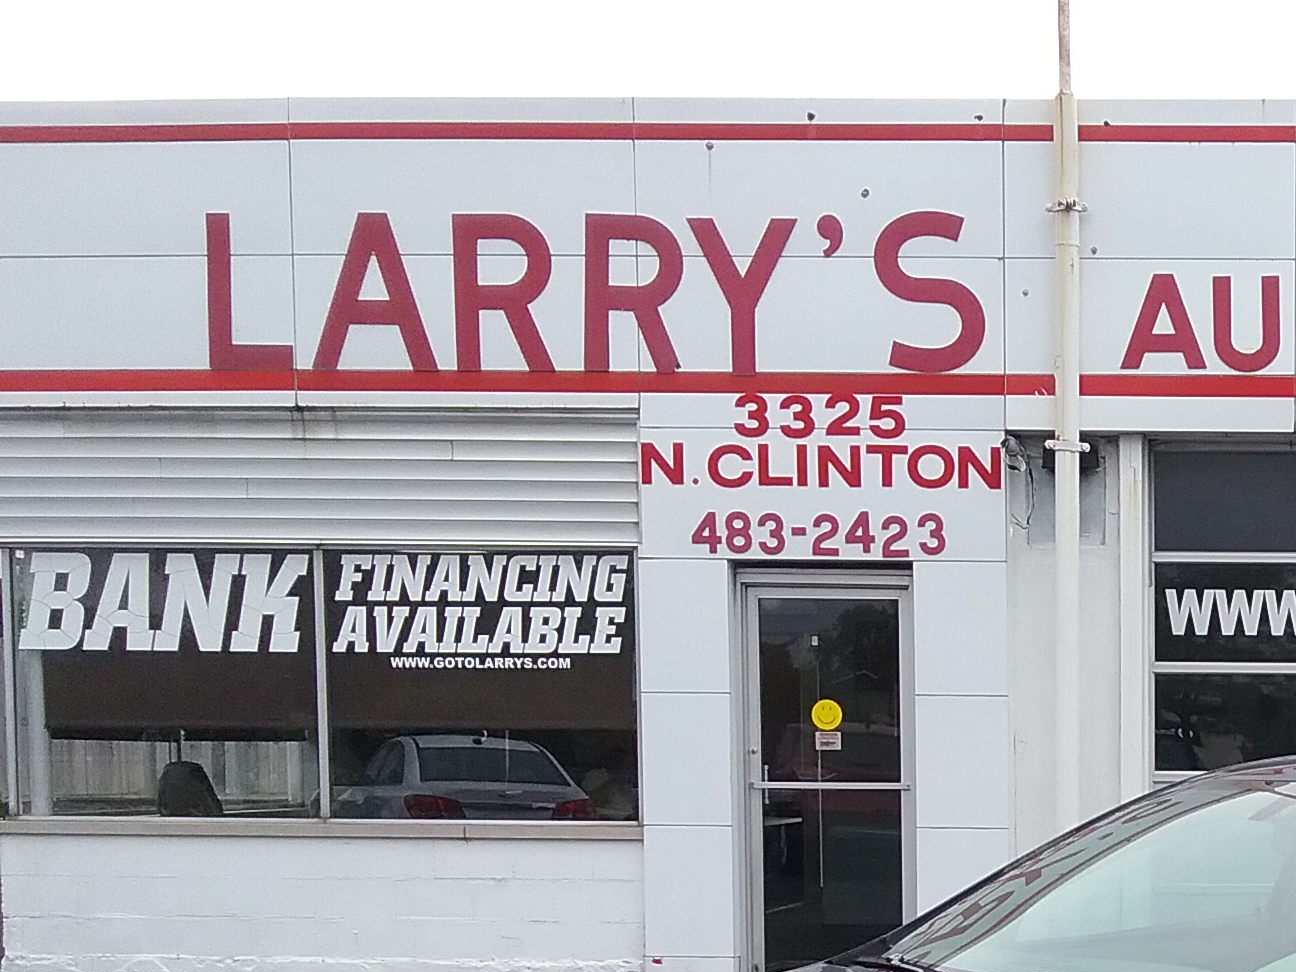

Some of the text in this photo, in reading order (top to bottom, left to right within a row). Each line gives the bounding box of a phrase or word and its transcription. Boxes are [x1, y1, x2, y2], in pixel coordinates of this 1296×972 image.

[205, 211, 986, 375] LARRY'S
[733, 393, 906, 440] 3325
[691, 510, 946, 558] 483-2423
[18, 551, 310, 653] BANK
[334, 554, 629, 603] FINANCING
[332, 605, 627, 655] AVAILABLE
[390, 656, 571, 670] WWW.GOTOLARRYS.COM
